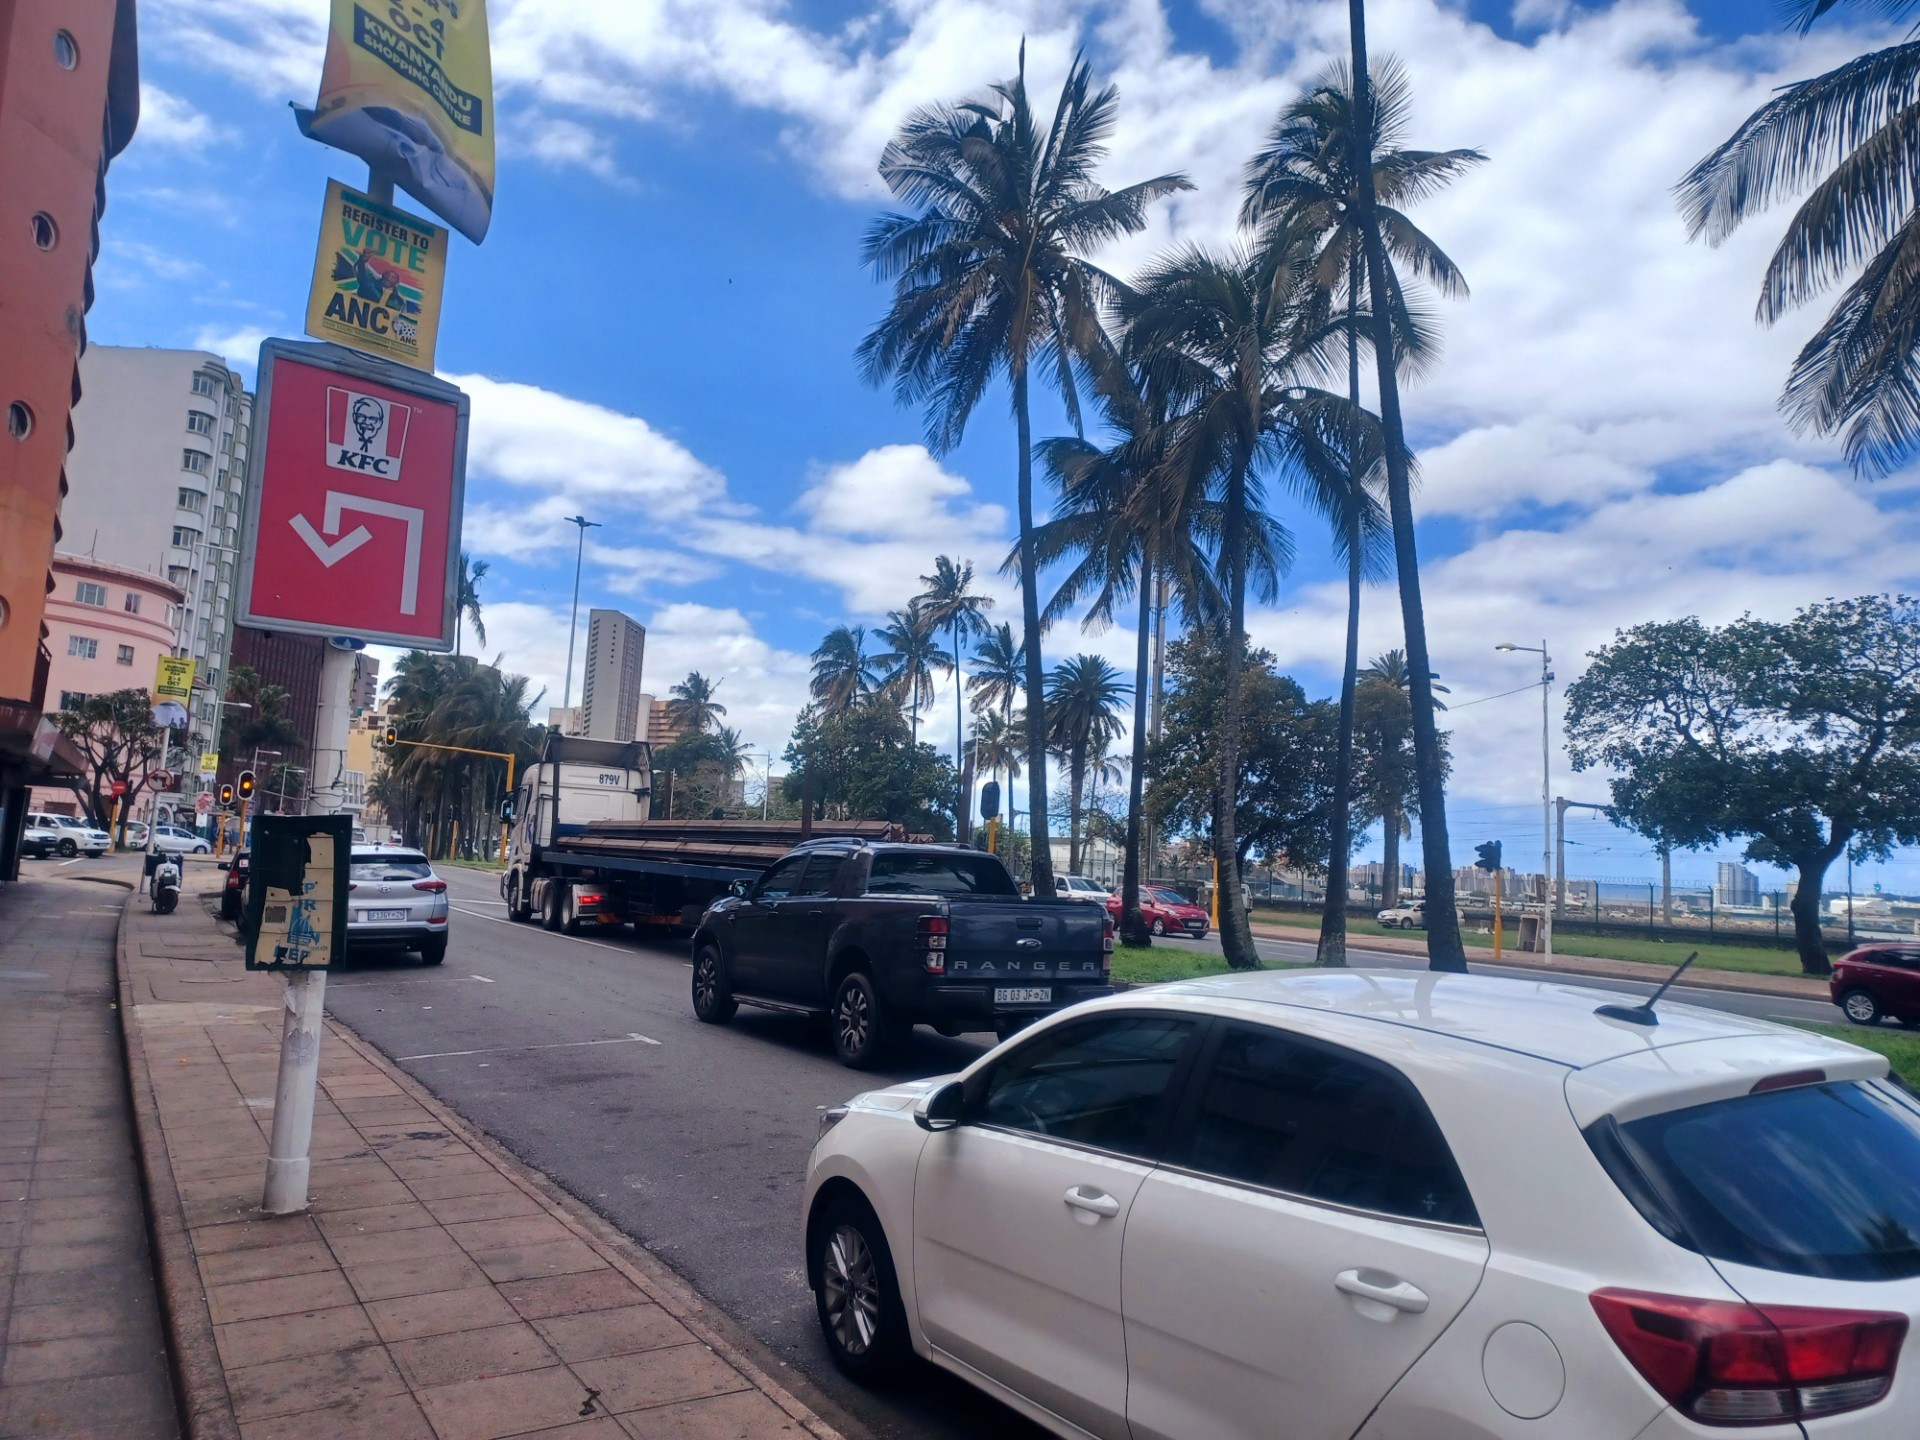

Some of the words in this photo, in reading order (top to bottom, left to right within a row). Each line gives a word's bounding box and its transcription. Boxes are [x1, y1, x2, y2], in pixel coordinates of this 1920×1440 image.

[388, 7, 445, 61] OCT
[363, 33, 430, 88] SHOPPING
[432, 84, 472, 126] CENTRE
[342, 204, 408, 242] REGISTER
[411, 232, 429, 250] TO
[342, 217, 428, 274] VOTE
[324, 291, 390, 335] ANC
[400, 335, 418, 346] ANC
[336, 449, 390, 475] KFC
[599, 774, 620, 786] 879V
[953, 960, 1095, 971] RANGER
[1010, 990, 1021, 1001] 03
[1023, 990, 1033, 1001] JF
[1039, 990, 1050, 1001] ZN
